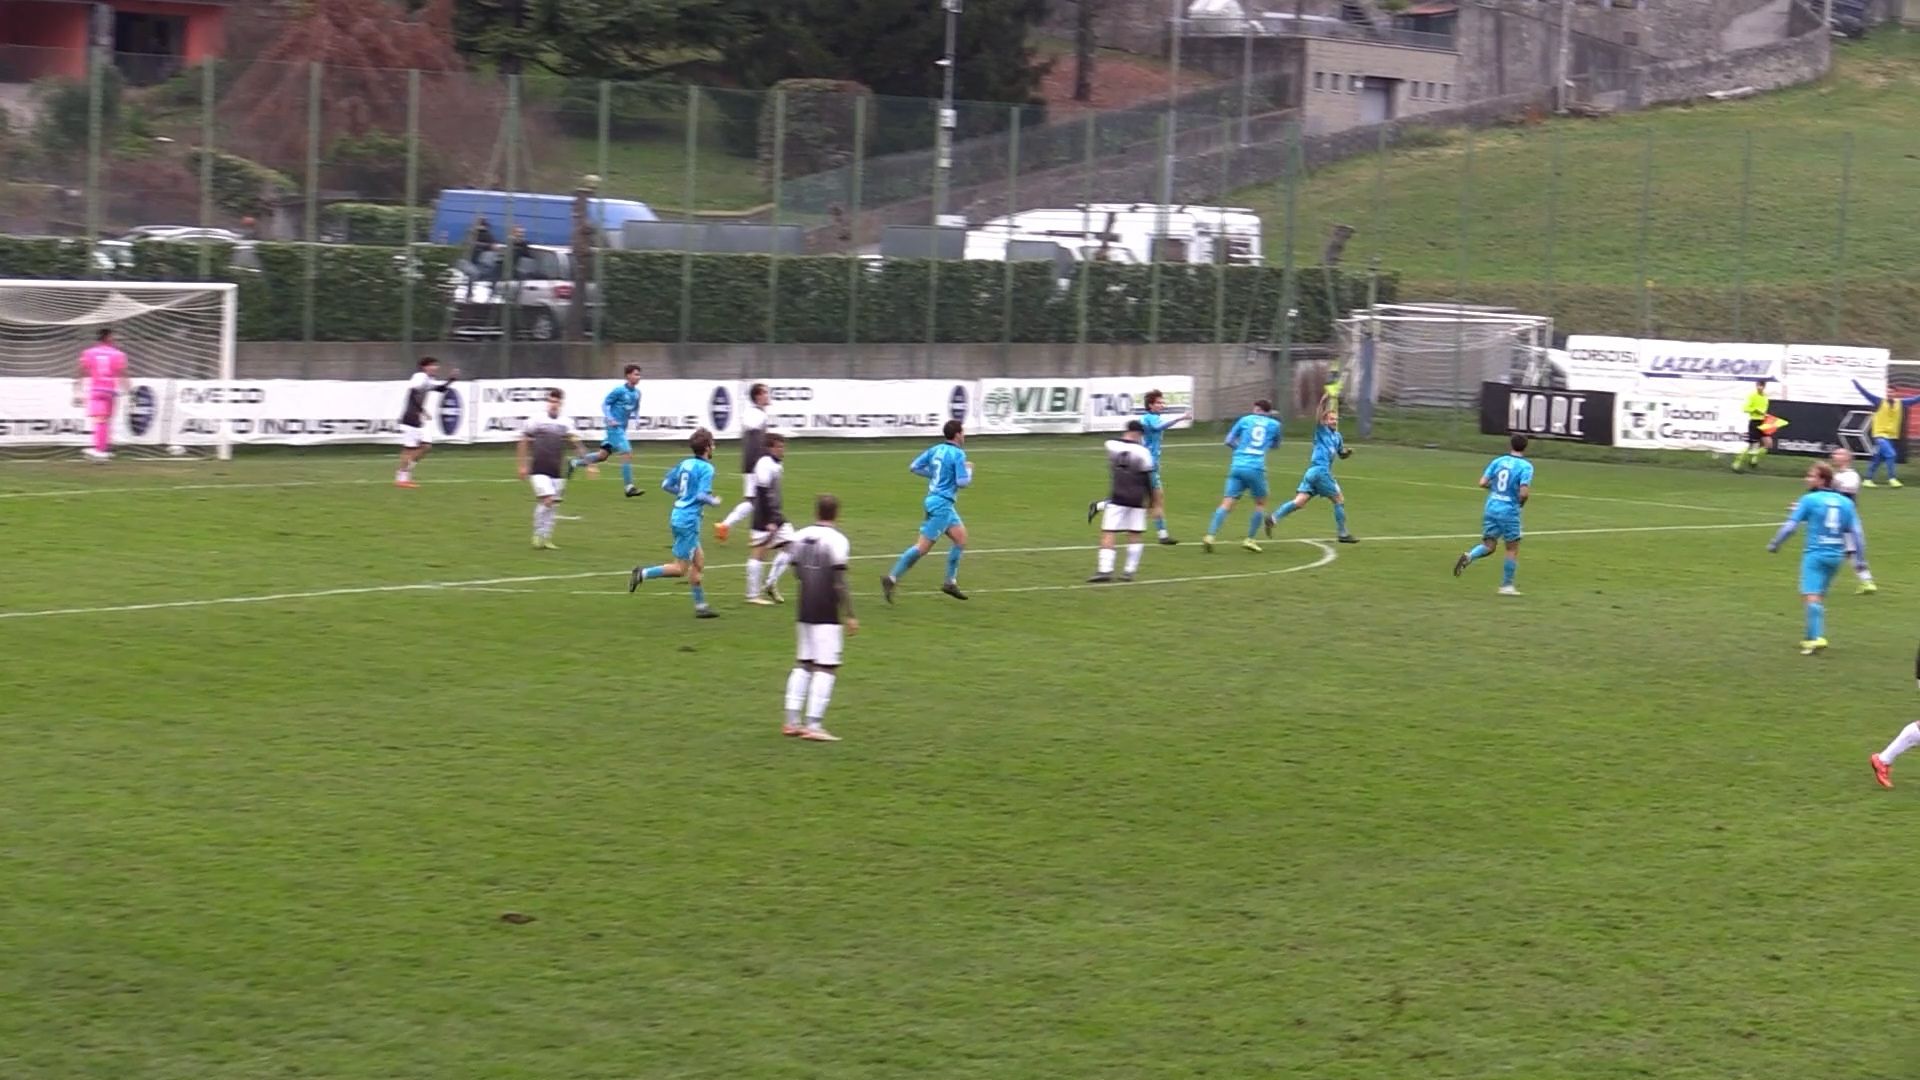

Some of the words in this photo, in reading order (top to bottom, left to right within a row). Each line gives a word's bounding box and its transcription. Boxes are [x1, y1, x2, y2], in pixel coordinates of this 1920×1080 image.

[767, 386, 814, 401] ECO
[1012, 386, 1084, 413] VIBI
[766, 413, 807, 429] UTO
[811, 413, 940, 429] INDUSTRIALE
[1508, 392, 1587, 436] MORE
[258, 418, 405, 434] INDUSTRIAL
[484, 416, 532, 432] AUT
[1250, 425, 1267, 448] 9
[1496, 468, 1510, 493] 8
